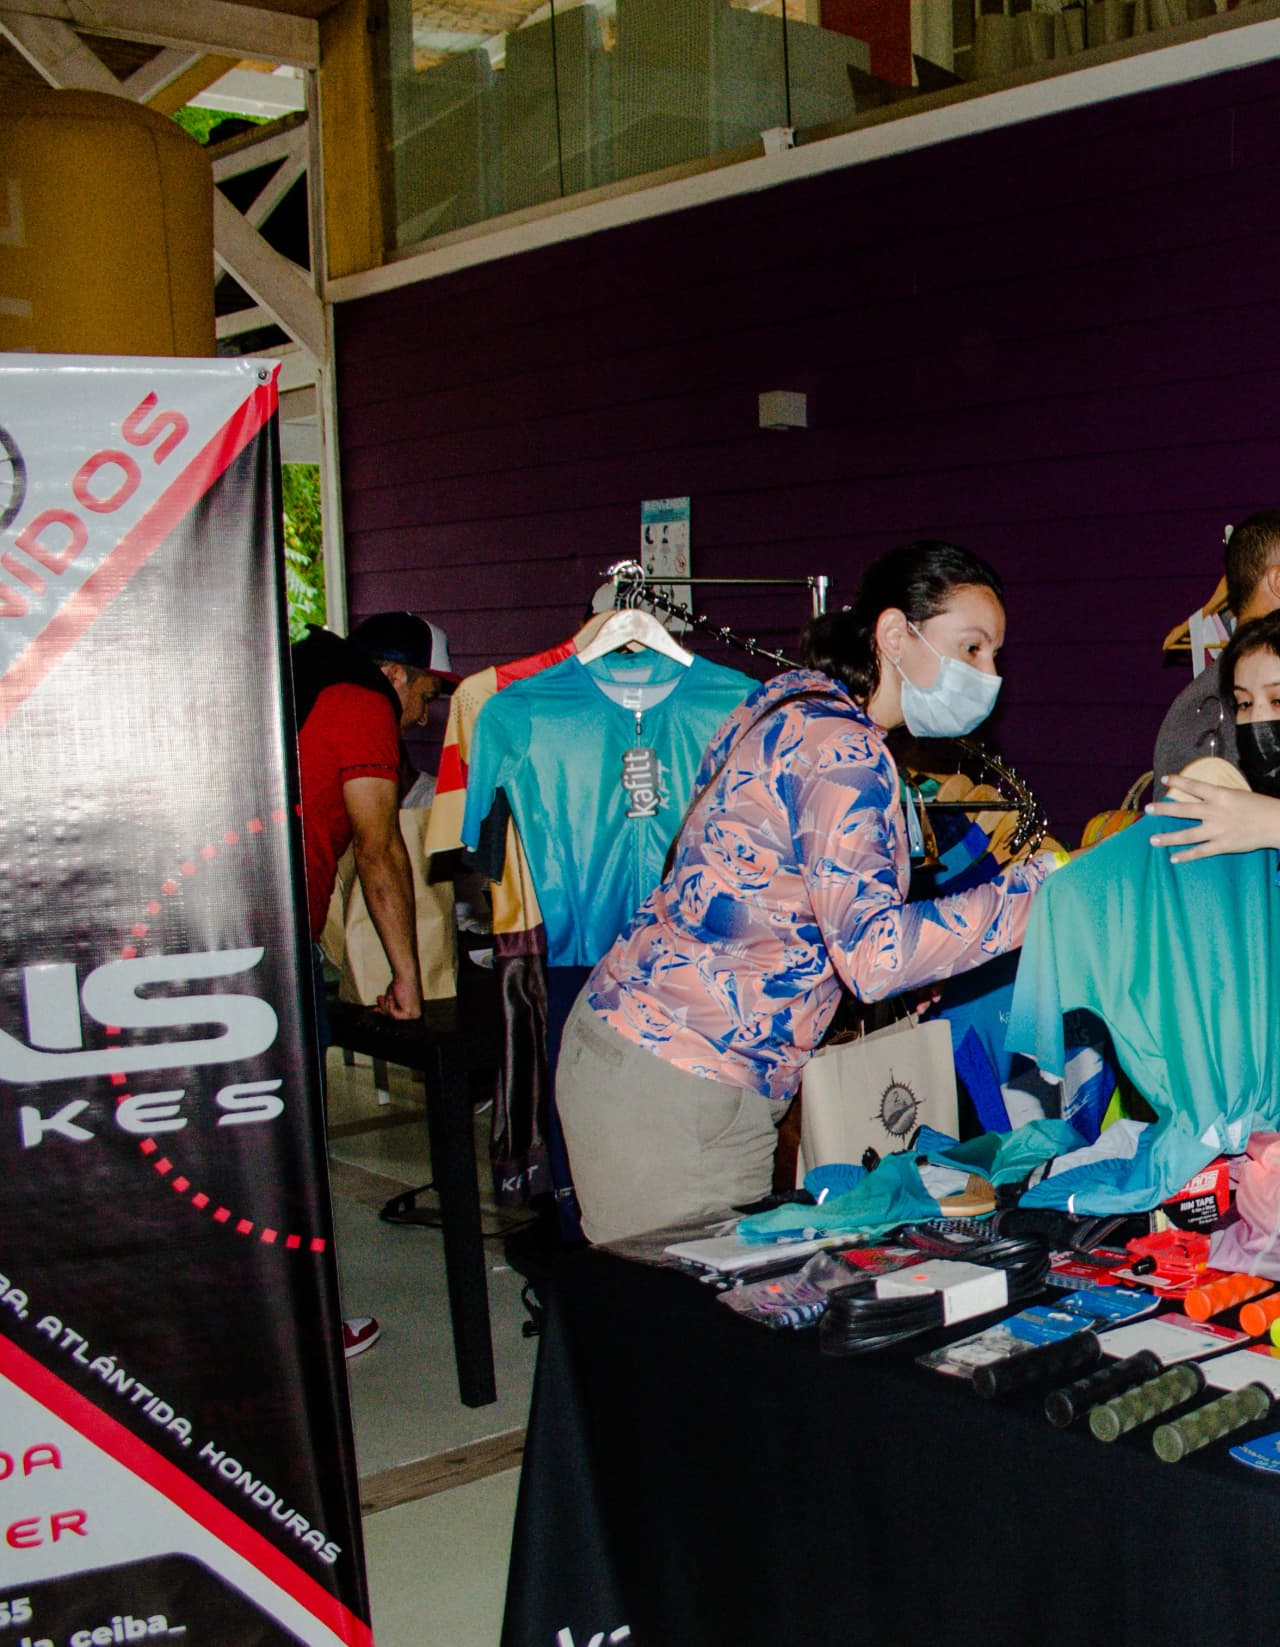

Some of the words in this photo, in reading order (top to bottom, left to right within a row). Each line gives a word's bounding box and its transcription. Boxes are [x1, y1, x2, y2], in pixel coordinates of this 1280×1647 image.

[624, 751, 659, 818] kafitt
[35, 1315, 193, 1446] ATLÁNTIDA,
[198, 1441, 344, 1565] HONDURAS
